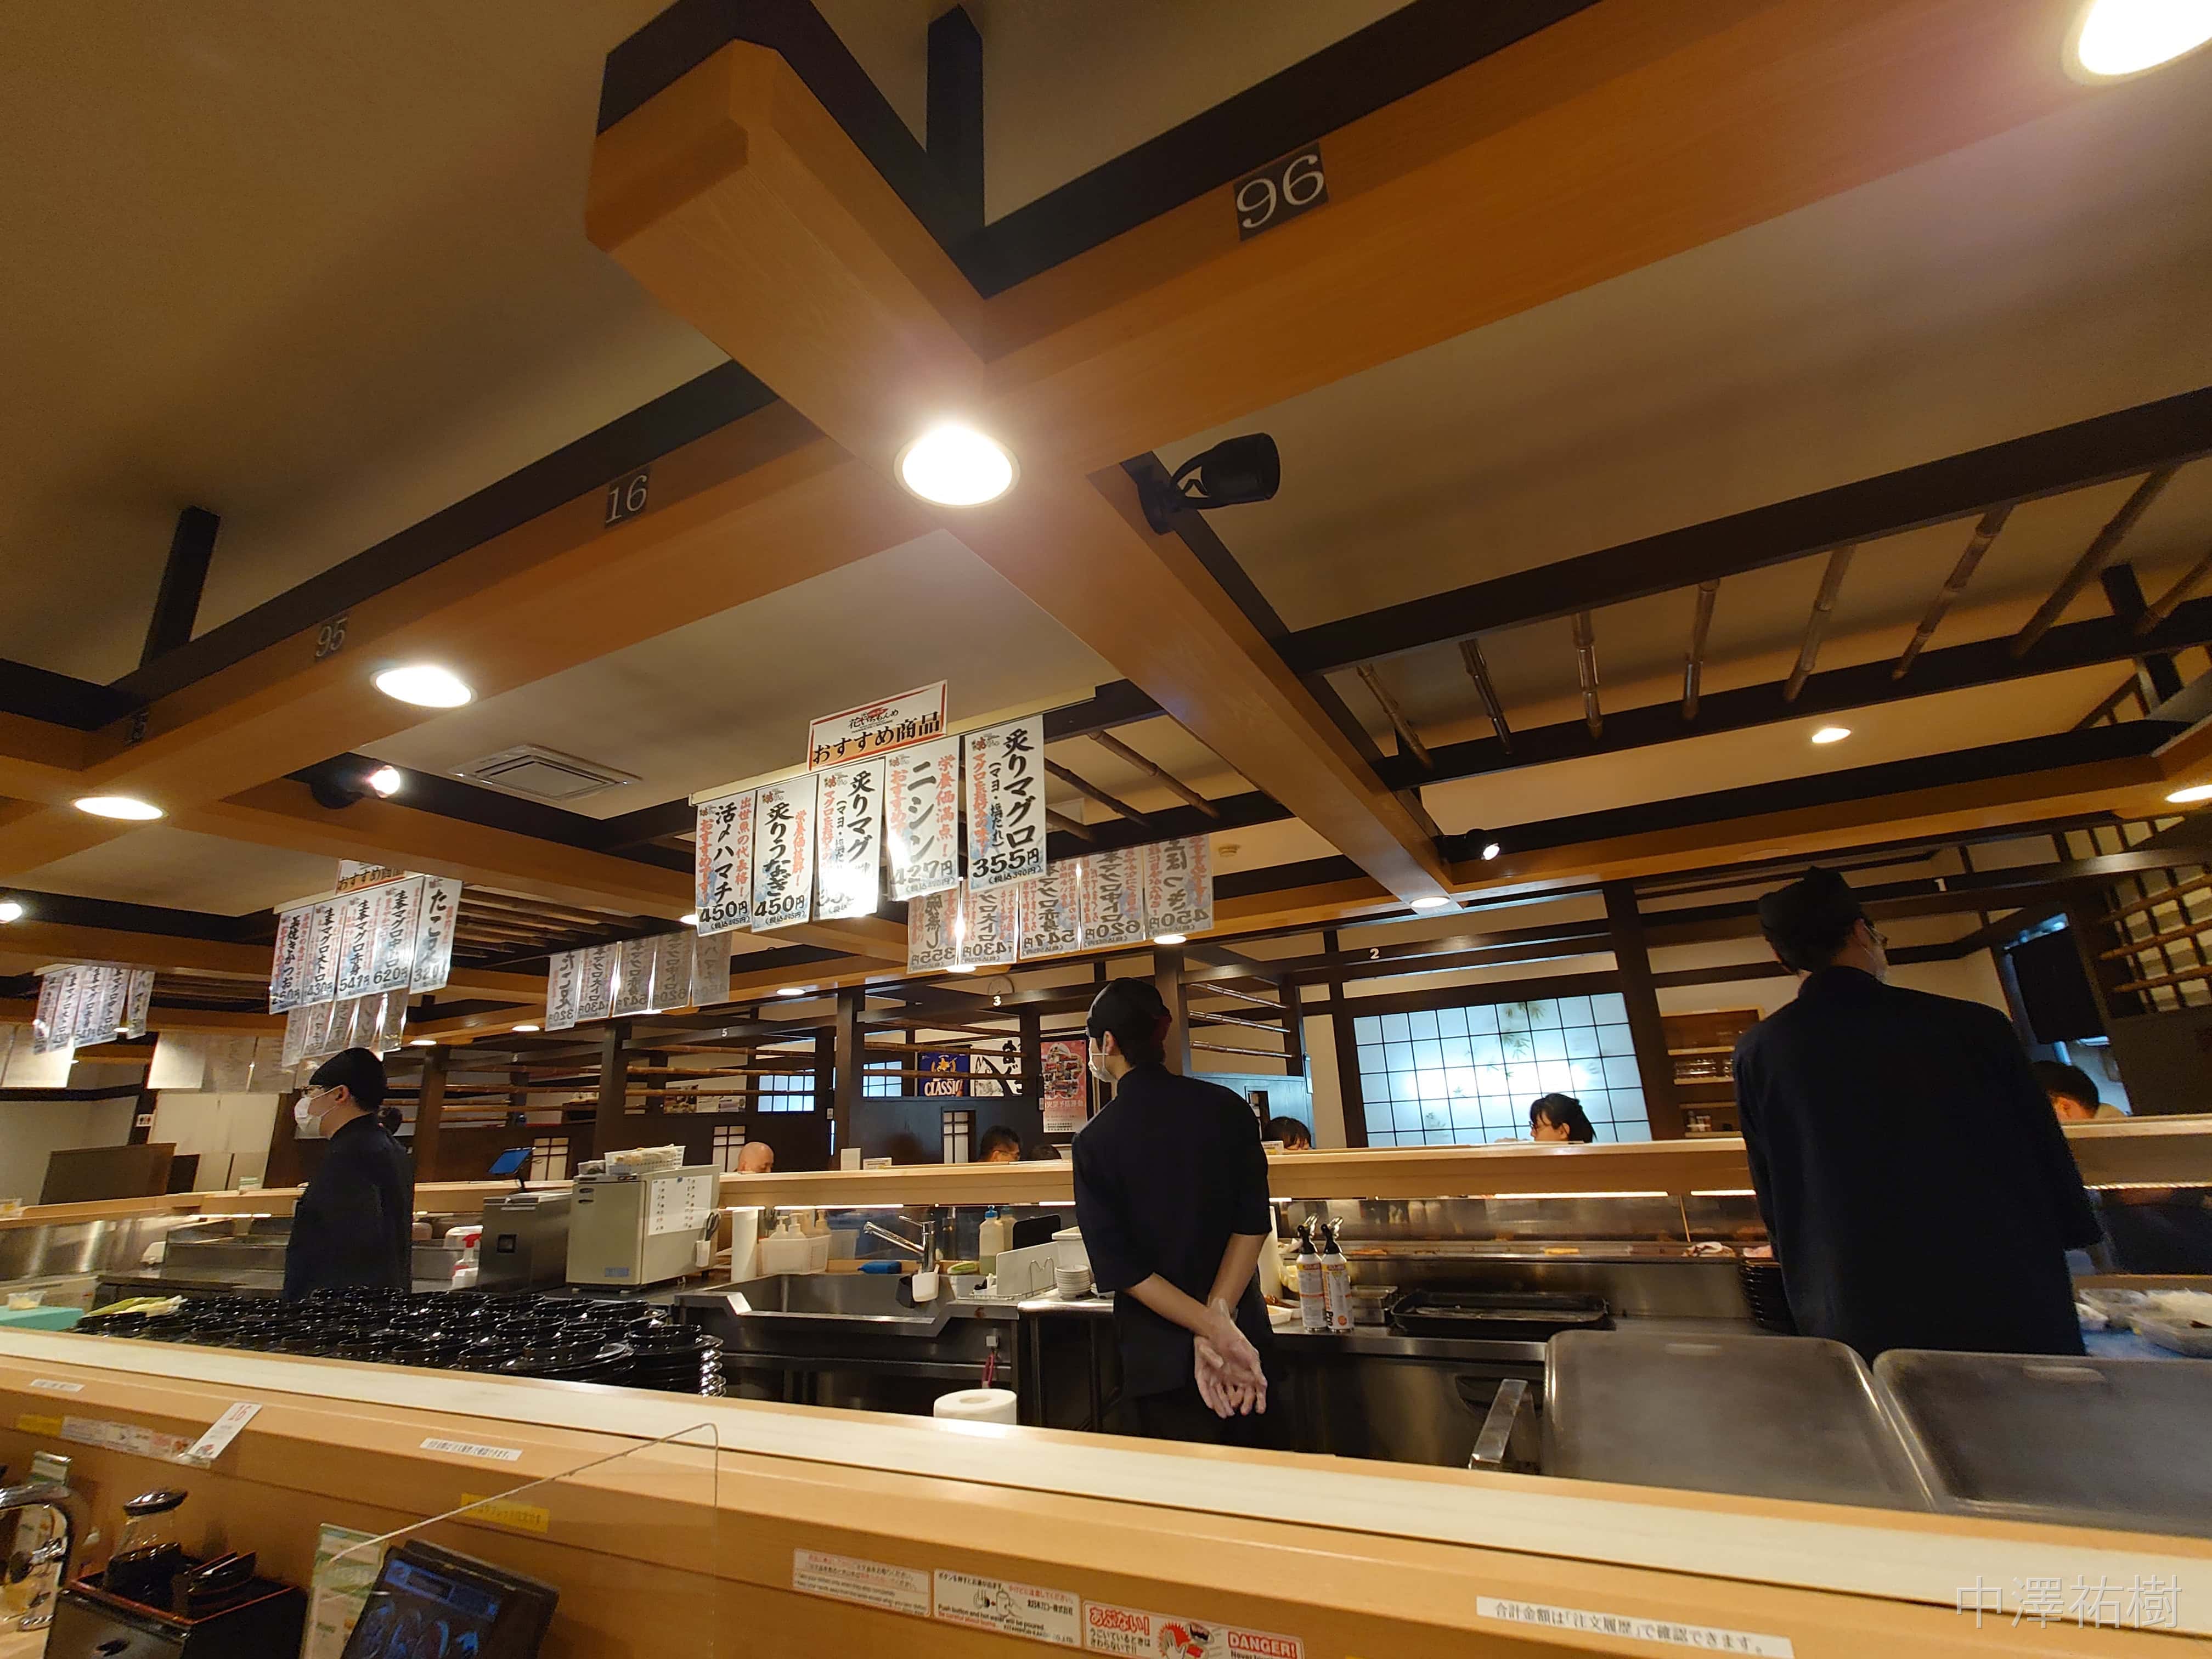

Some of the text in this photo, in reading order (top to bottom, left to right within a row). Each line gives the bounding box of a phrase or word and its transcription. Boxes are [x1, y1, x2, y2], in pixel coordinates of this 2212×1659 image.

[1237, 155, 1324, 228] 96
[606, 475, 647, 523] 16
[315, 617, 347, 657] 95
[813, 712, 940, 764] おすすめ商品
[1001, 729, 1036, 848] 炙りマグロ
[847, 770, 875, 873] 炙りマグ
[908, 761, 936, 863] ニシン
[765, 802, 794, 896] 炙りうなぎ
[973, 848, 1039, 878] 355円
[891, 860, 952, 885] 427円
[989, 866, 1041, 884] (税込390円)
[1934, 878, 1947, 891] 1
[700, 900, 748, 922] 450円
[754, 895, 805, 917] 450円
[386, 890, 409, 968] 生本マグロ中ロ
[1370, 948, 1380, 959] 2
[993, 996, 1001, 1006] 3
[721, 1028, 727, 1037] 5
[228, 1405, 252, 1421] 16
[1496, 1601, 1762, 1654] 合計金額は「注文履歴」で確認できます。
[1228, 1631, 1297, 1658] DANGER!
